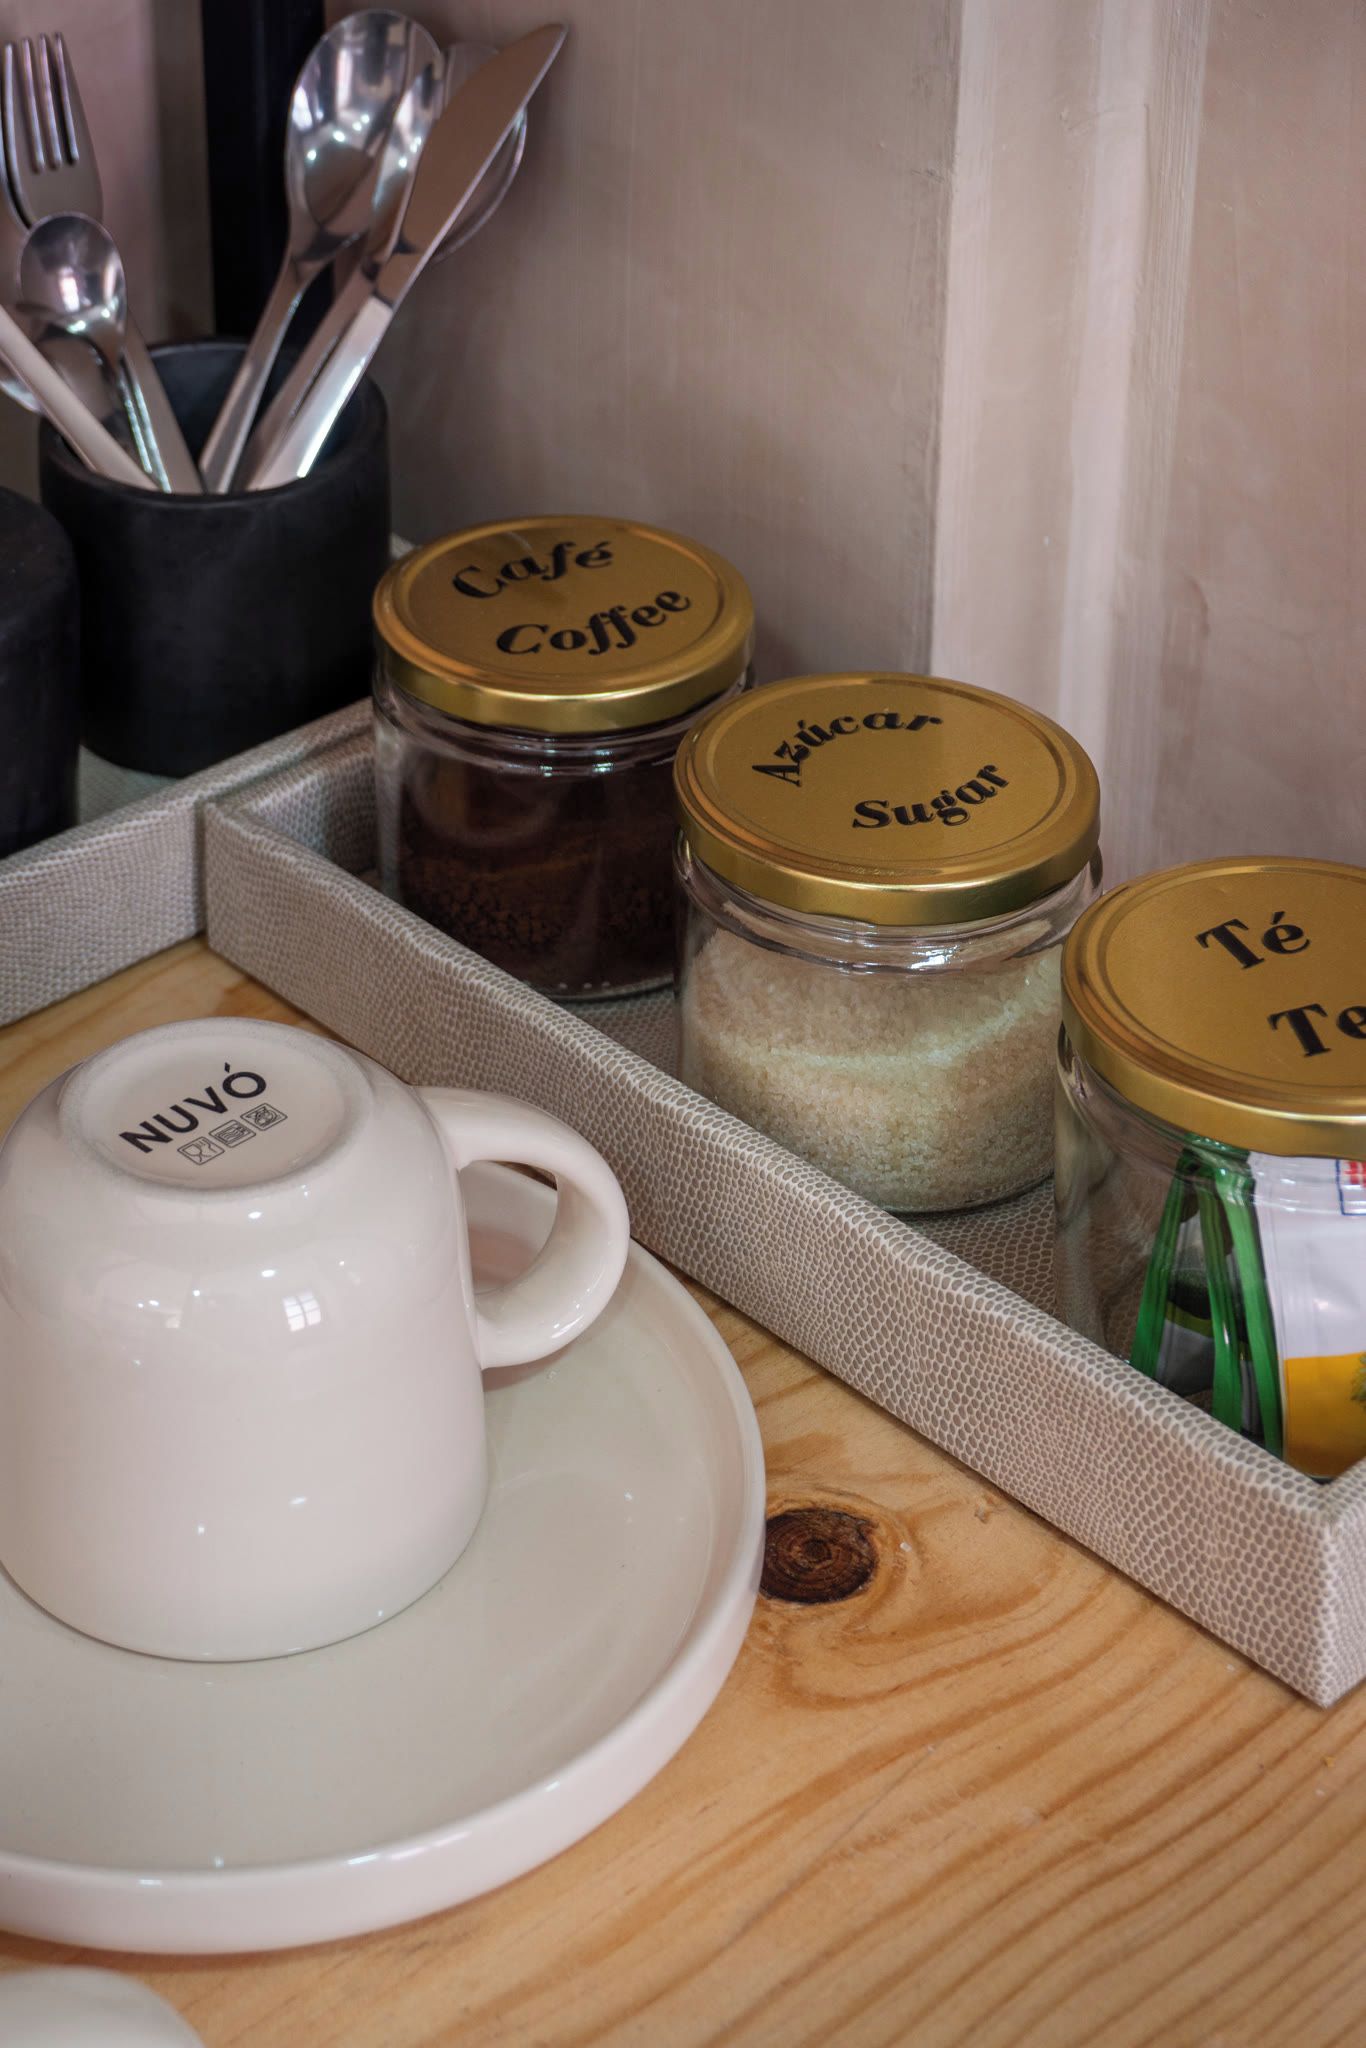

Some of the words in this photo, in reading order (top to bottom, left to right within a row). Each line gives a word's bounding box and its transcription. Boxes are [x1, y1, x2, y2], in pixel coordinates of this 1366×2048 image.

[452, 540, 614, 599] Café
[496, 590, 691, 655] Coffee
[752, 711, 943, 788] Azúcar
[852, 764, 1010, 829] Sugar
[1195, 911, 1311, 970] Té
[118, 1061, 267, 1154] NUVÓ
